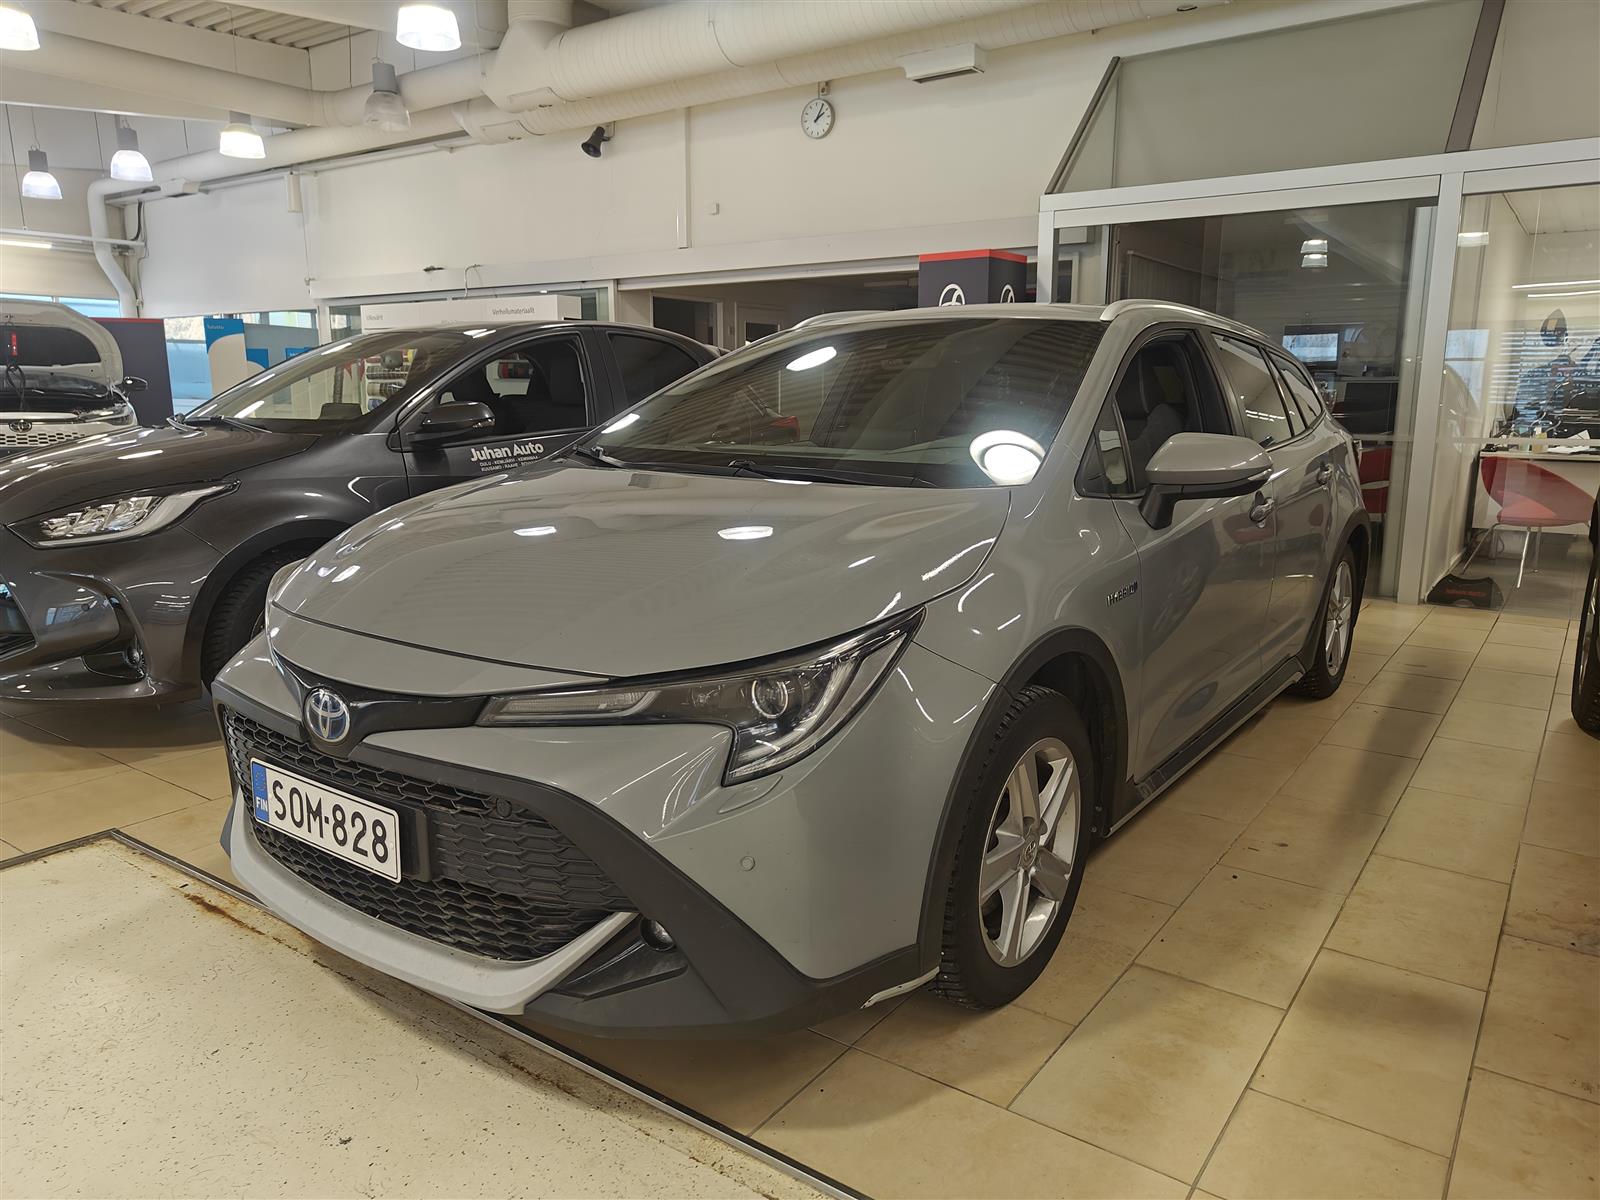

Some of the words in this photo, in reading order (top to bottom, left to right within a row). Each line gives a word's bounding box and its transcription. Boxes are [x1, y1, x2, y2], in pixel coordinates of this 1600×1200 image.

[471, 446, 512, 462] Juhan
[513, 442, 544, 456] Auto
[256, 796, 269, 812] FIN
[272, 780, 389, 864] SOM-828
